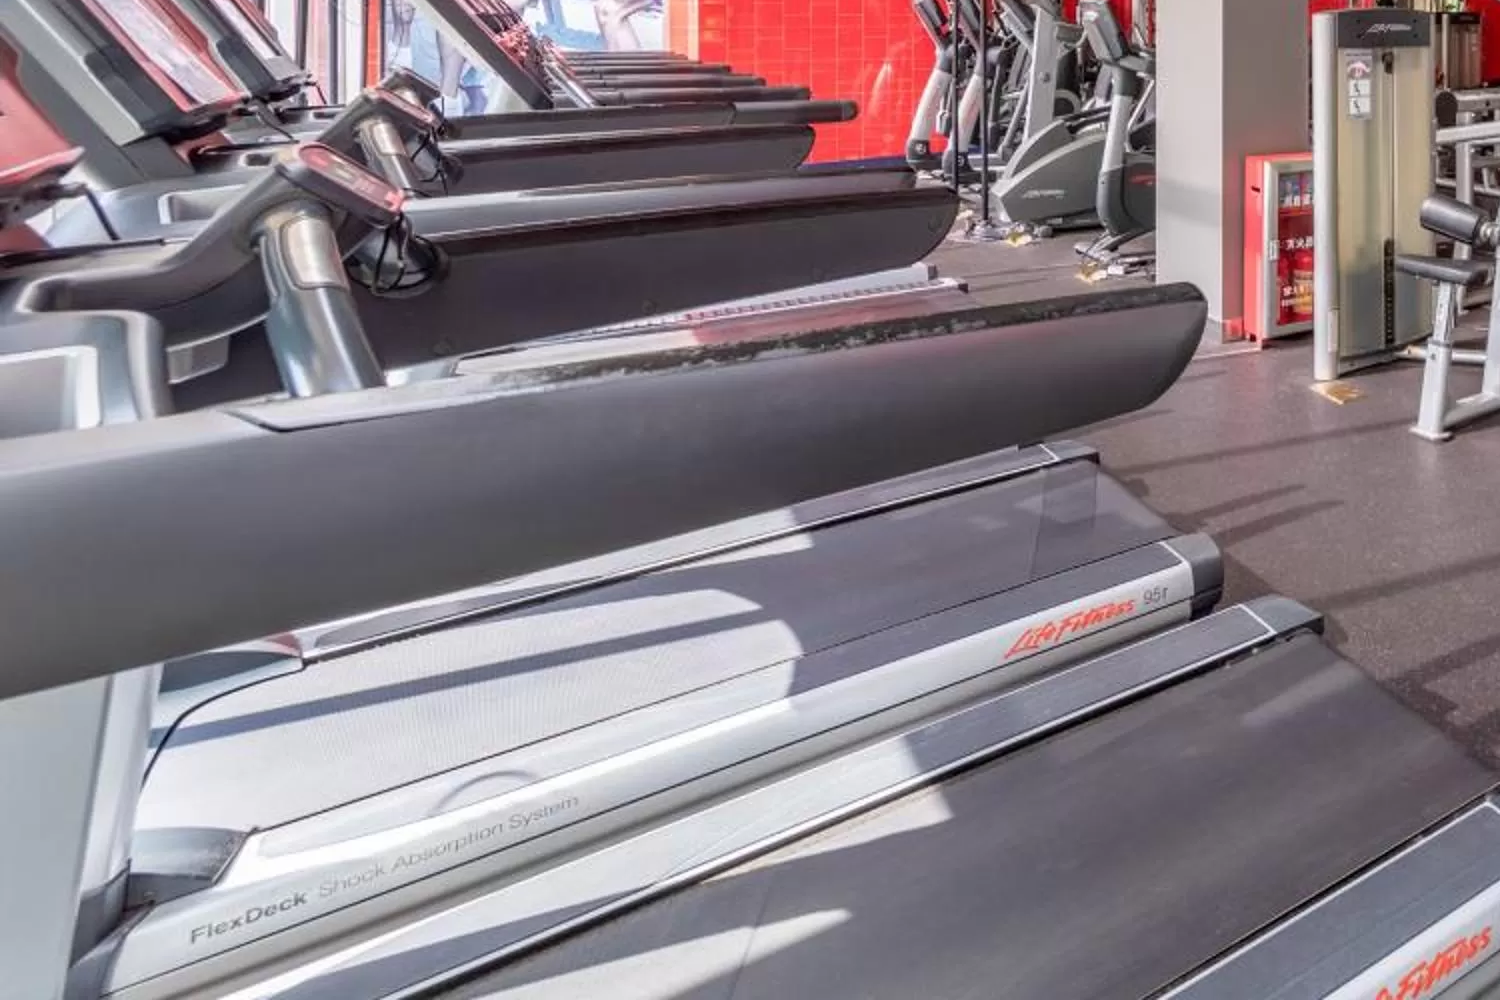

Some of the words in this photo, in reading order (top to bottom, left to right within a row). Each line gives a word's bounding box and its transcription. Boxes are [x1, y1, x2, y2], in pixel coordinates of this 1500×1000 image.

[191, 891, 308, 945] FlexDeck
[319, 862, 385, 898] Shock
[391, 823, 504, 874] Absorption
[508, 795, 580, 830] System
